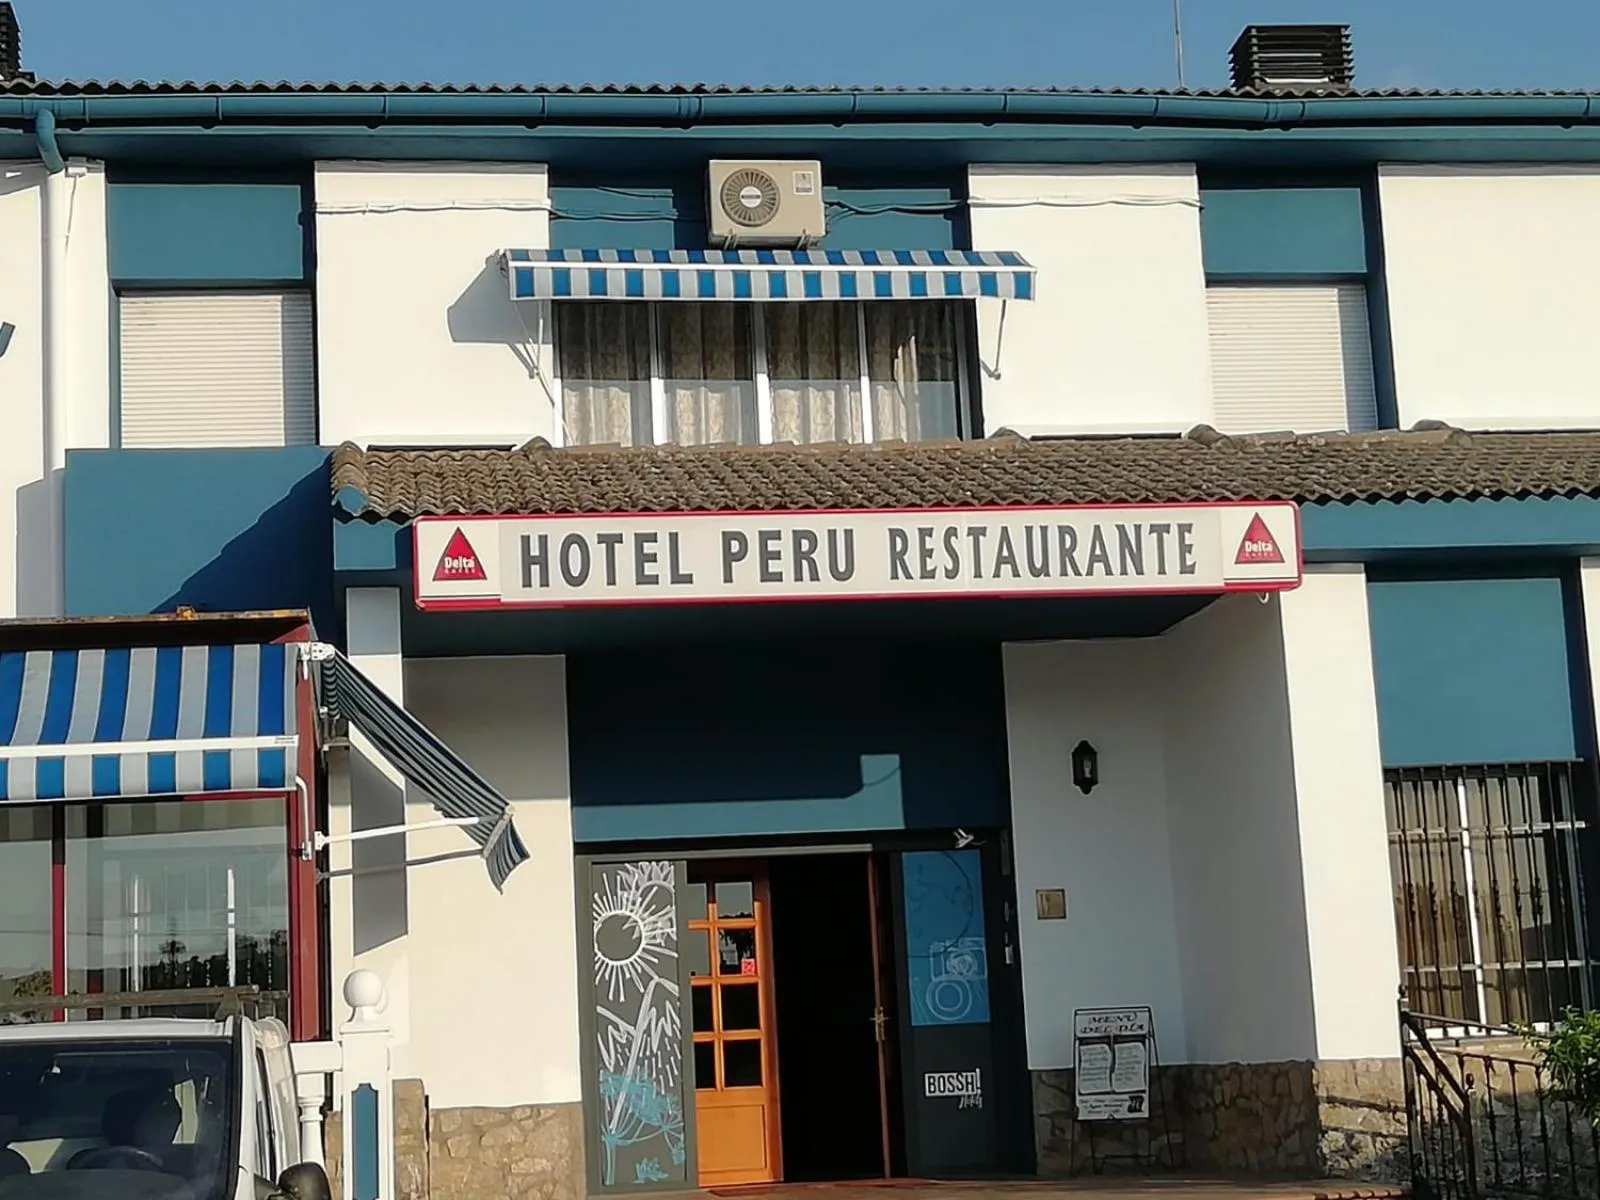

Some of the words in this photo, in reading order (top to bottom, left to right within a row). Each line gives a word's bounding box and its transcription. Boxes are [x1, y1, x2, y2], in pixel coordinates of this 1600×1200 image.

[1244, 540, 1273, 552] Delta
[520, 531, 694, 589] HOTEL
[721, 528, 855, 584] PERU
[887, 522, 1197, 581] RESTAURANTE
[444, 556, 475, 568] Delta
